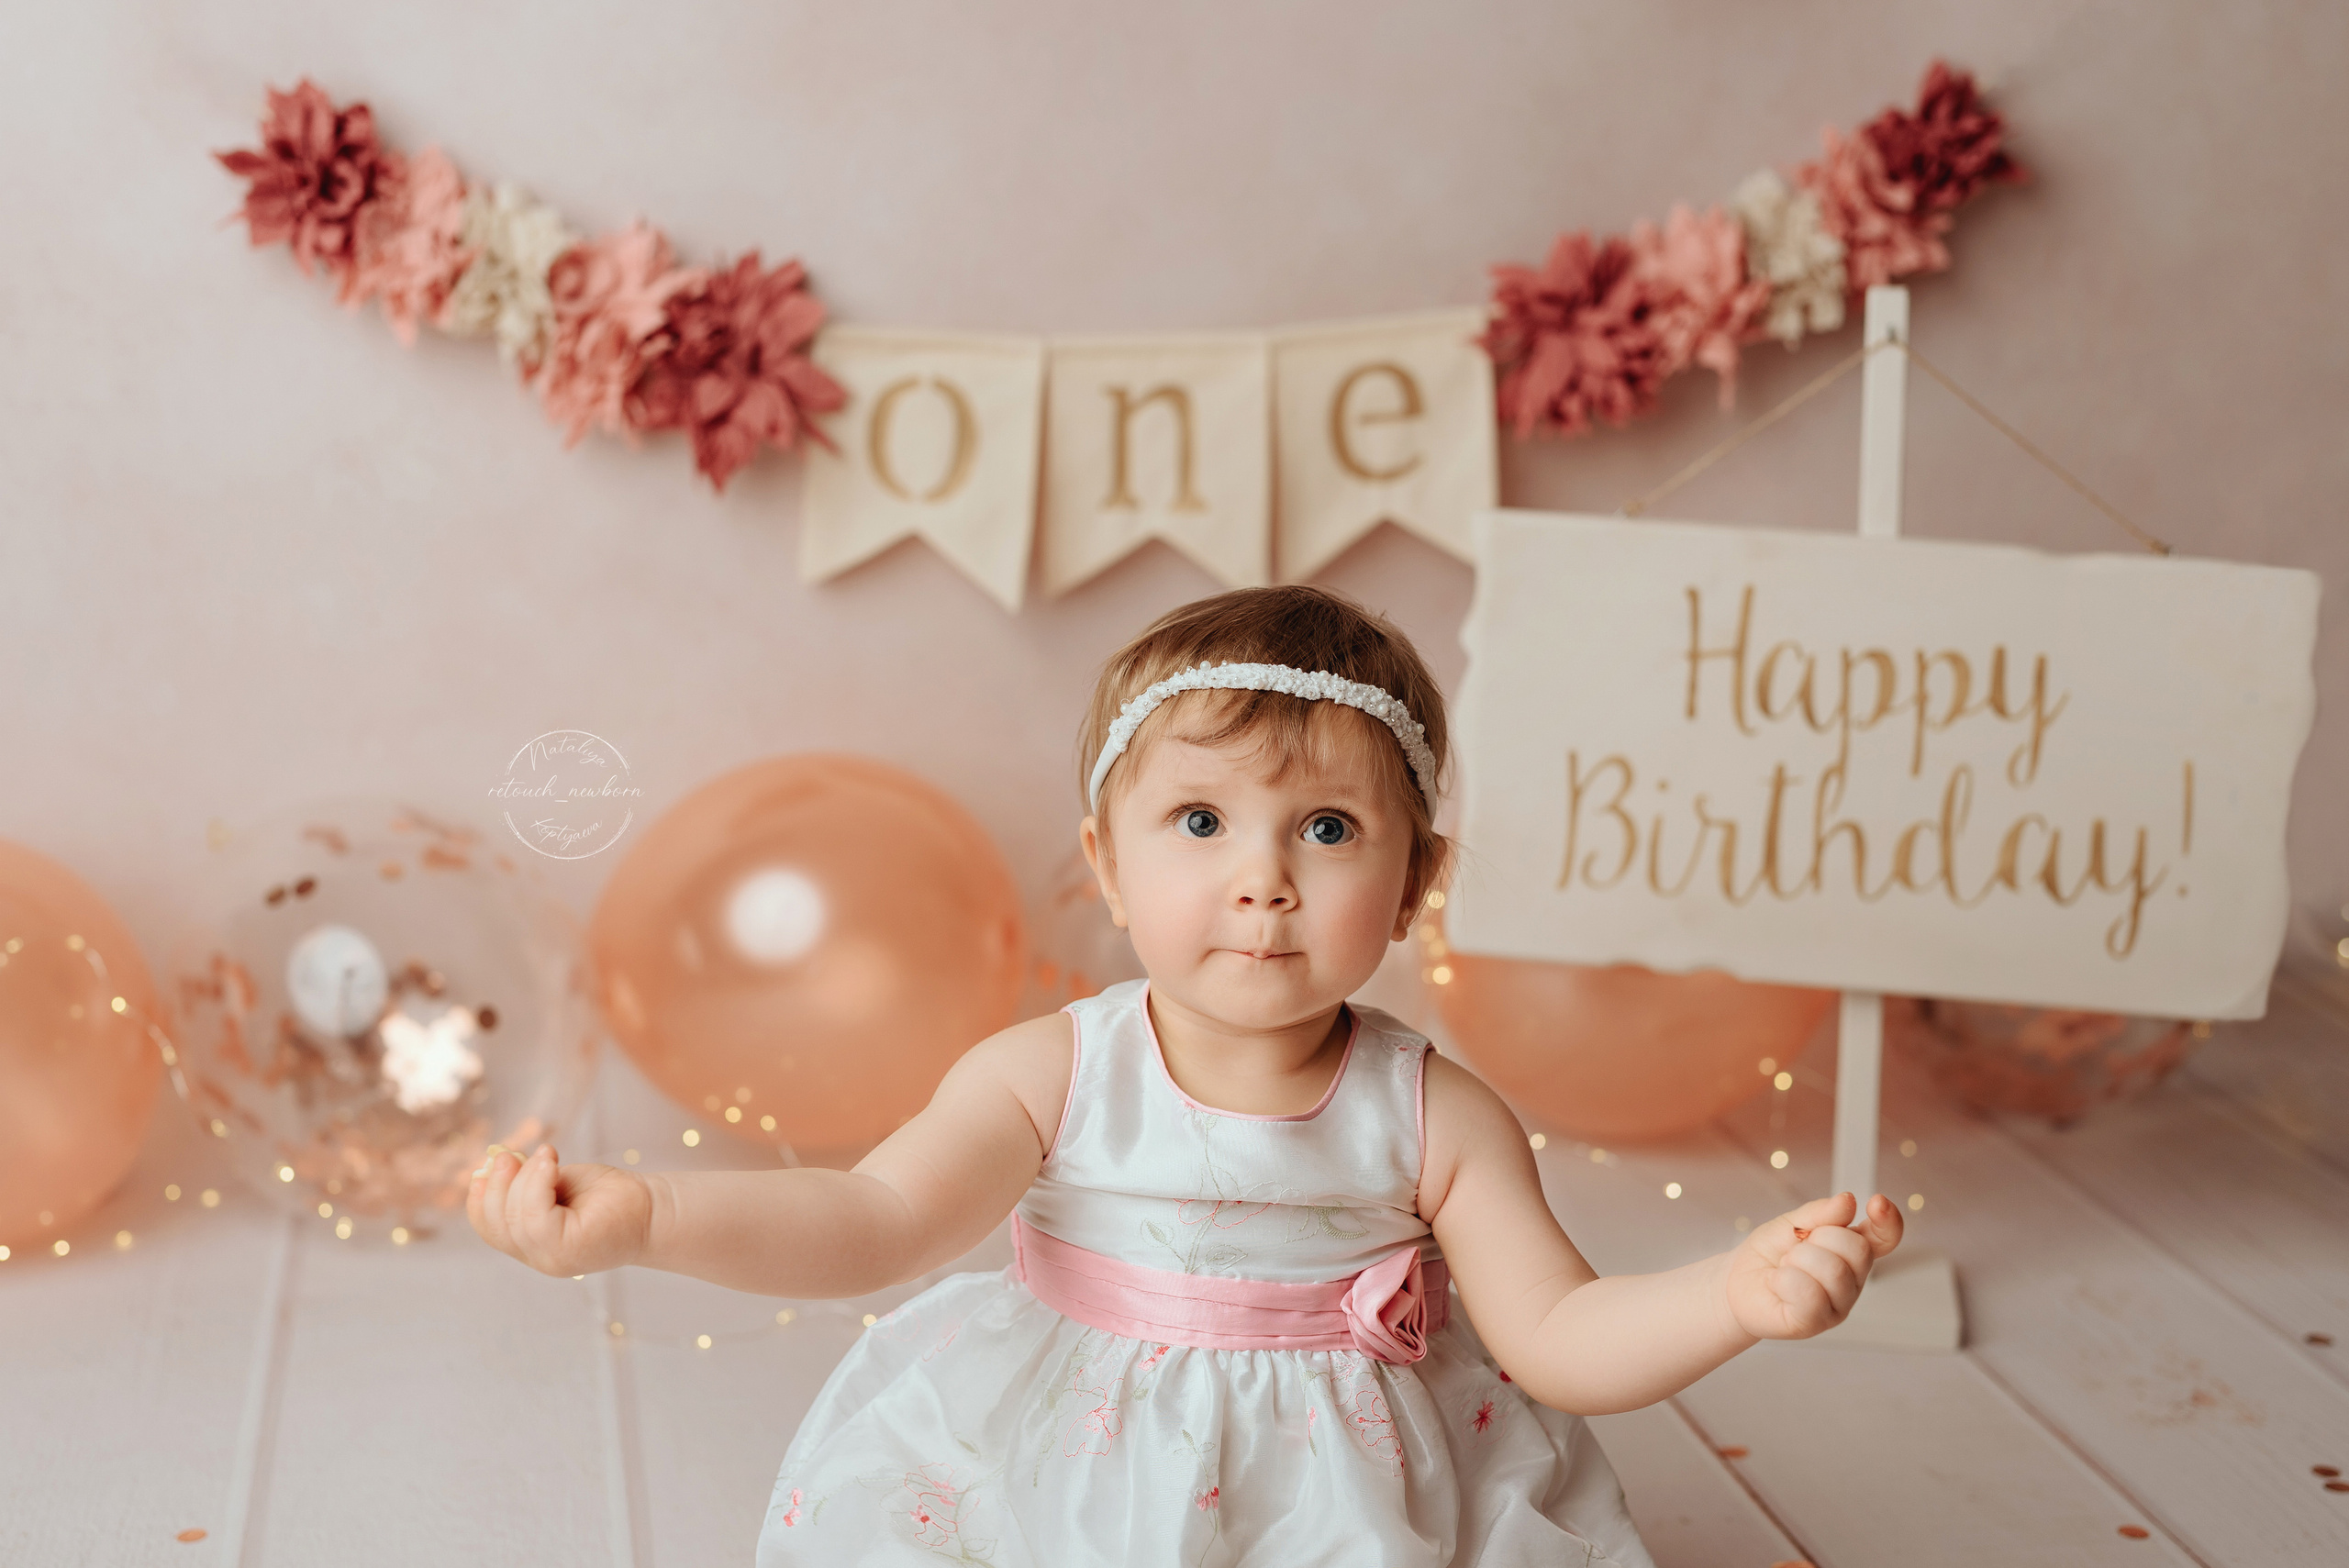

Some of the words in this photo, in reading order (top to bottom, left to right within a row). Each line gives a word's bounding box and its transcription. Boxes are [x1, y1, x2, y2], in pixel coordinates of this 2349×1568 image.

[864, 361, 1427, 514] one
[1683, 584, 2070, 789] Happy
[1556, 750, 2196, 962] Birthday!
